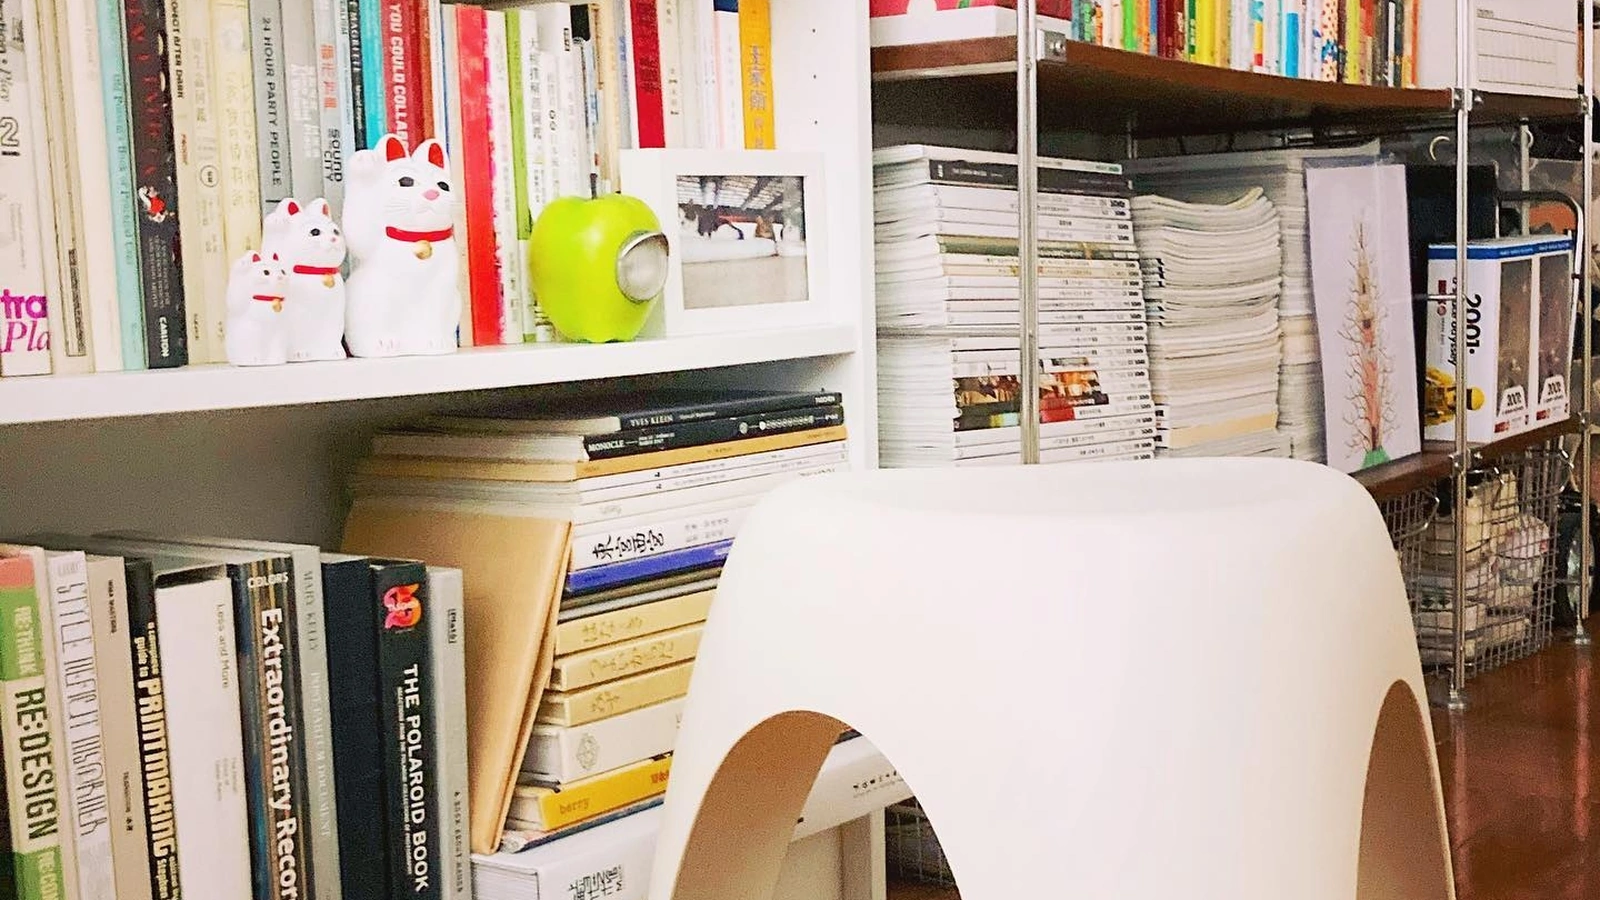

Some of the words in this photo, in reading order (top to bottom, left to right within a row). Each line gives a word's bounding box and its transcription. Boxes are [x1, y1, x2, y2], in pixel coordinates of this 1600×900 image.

[262, 17, 272, 32] 24
[389, 3, 404, 33] YOU
[263, 36, 275, 77] HOUR
[391, 36, 406, 84] COULD
[266, 82, 278, 127] PARTY
[0, 116, 20, 147] 2
[269, 131, 283, 186] PEOPLE
[323, 150, 334, 182] CITY
[0, 289, 48, 320] tra
[1, 320, 51, 353] Pla
[159, 316, 170, 358] CARLTON
[630, 418, 649, 428] YVES
[650, 414, 674, 425] KLEIN
[587, 439, 626, 453] MONOCLE
[303, 570, 316, 608] MARY
[216, 603, 228, 632] Less
[305, 611, 320, 652] KELLY
[134, 636, 148, 665] guide
[217, 635, 230, 657] and
[139, 666, 150, 678] to
[219, 659, 232, 689] More
[403, 663, 420, 709] THE
[260, 606, 294, 811] Extraordinary
[14, 686, 59, 841] RE:DESIGN
[138, 676, 176, 859] PRINTMAKING
[406, 714, 426, 825] POLAROID
[155, 858, 170, 899] Stephen
[412, 830, 430, 893] BOOK
